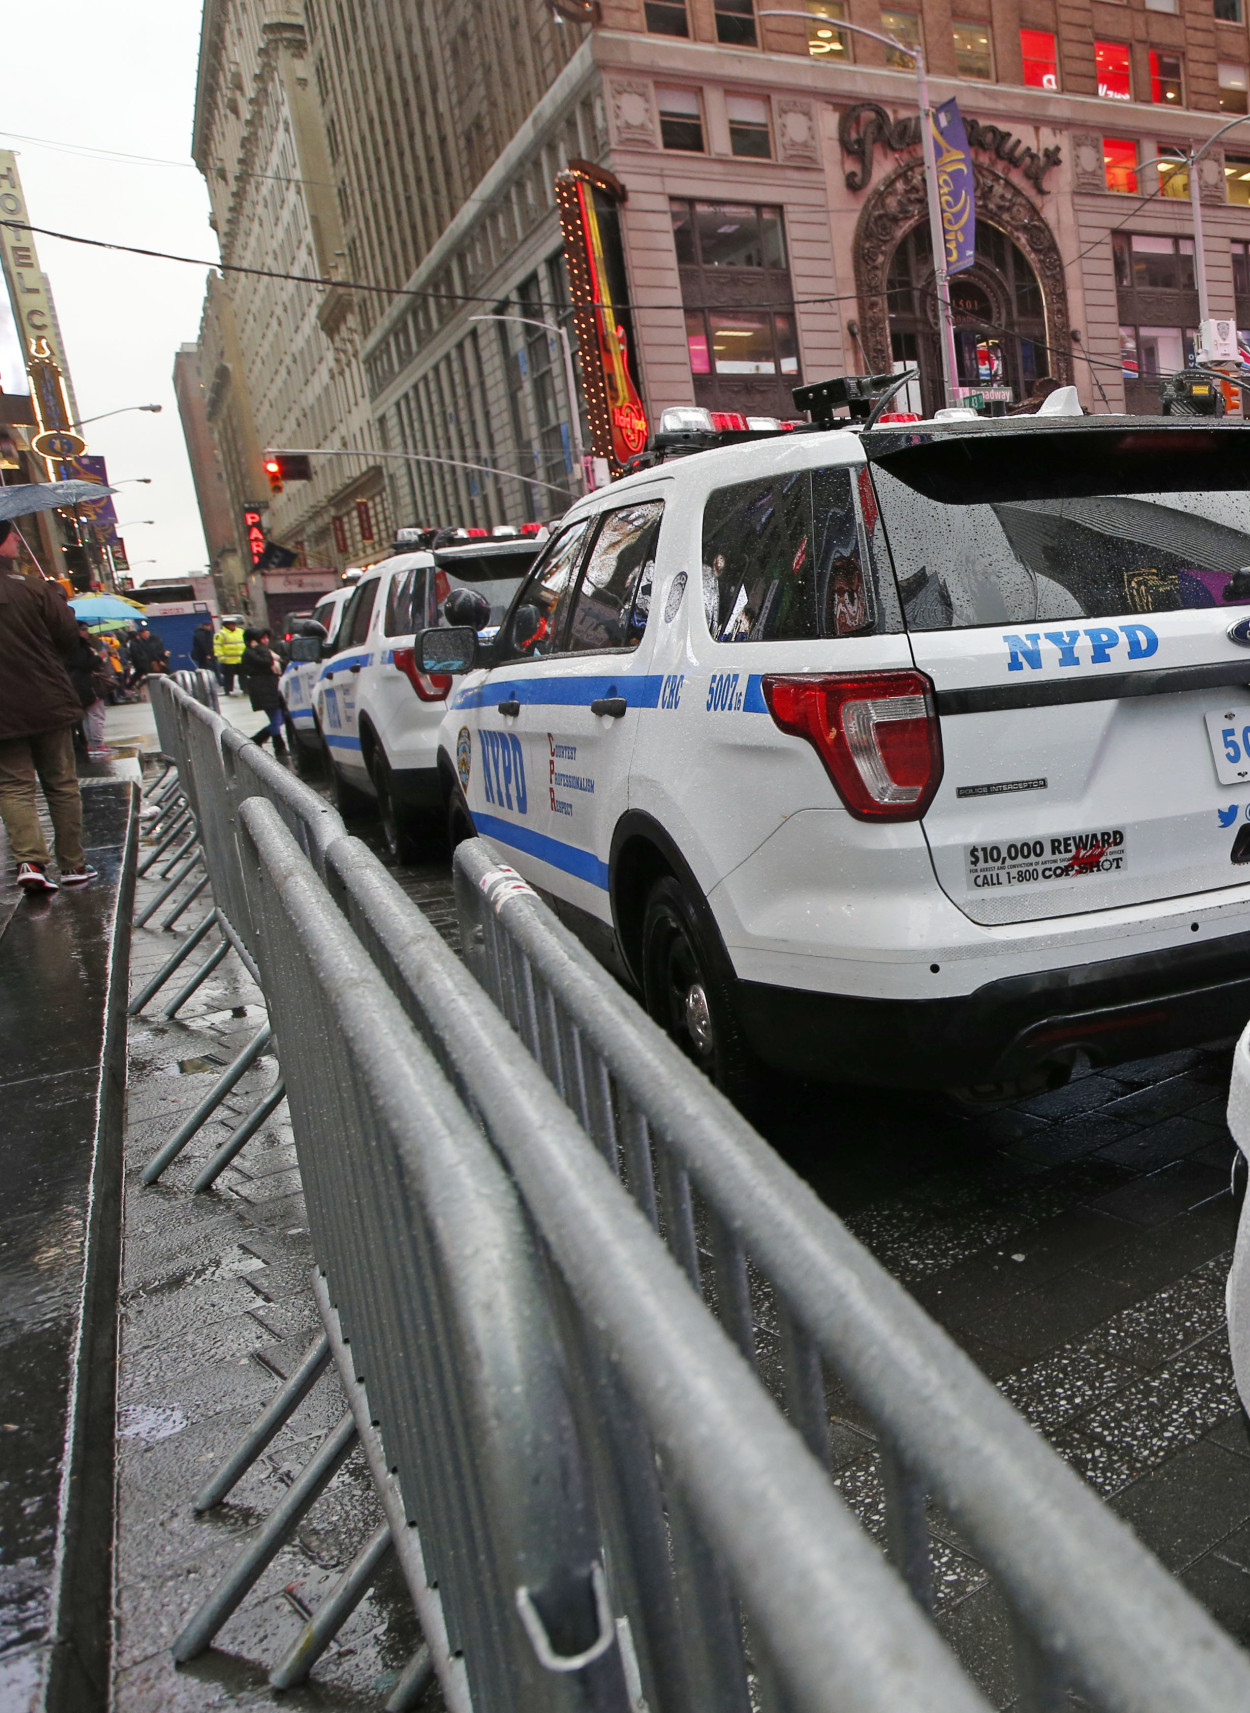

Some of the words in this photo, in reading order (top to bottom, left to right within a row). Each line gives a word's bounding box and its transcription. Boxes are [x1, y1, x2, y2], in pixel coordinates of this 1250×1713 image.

[1002, 624, 1159, 672] NYPD
[706, 673, 739, 712] 5007
[478, 728, 528, 815] NYPD
[959, 787, 988, 795] POLICE
[990, 780, 1044, 792] INTERCEPTOR
[969, 841, 1045, 867] $10,000
[1050, 829, 1124, 856] REWARD
[1007, 861, 1034, 870] CONVICTION
[973, 874, 1003, 888] CALL
[1006, 868, 1039, 884] 1-800
